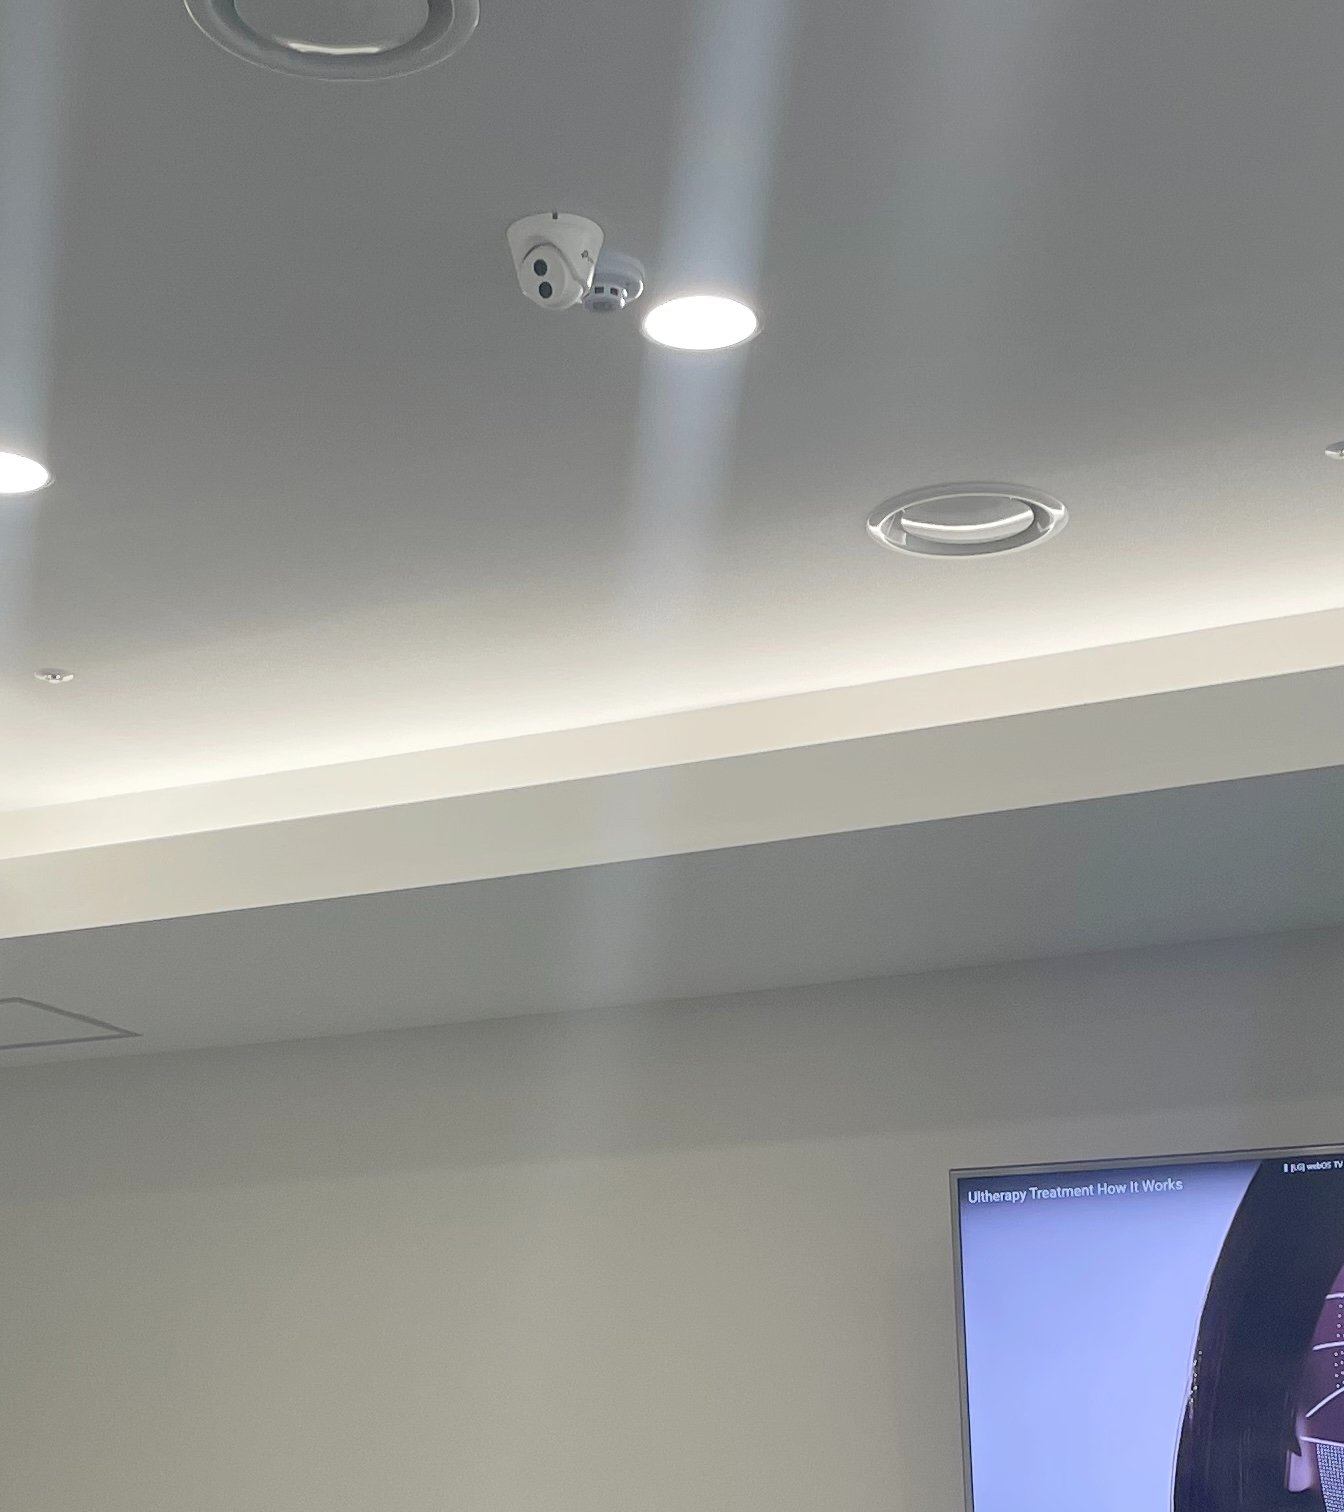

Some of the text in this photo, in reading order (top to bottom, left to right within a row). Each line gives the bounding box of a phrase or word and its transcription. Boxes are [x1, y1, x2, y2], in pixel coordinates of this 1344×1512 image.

[967, 1177, 1184, 1204] Ultherapy Treatment How It Works
